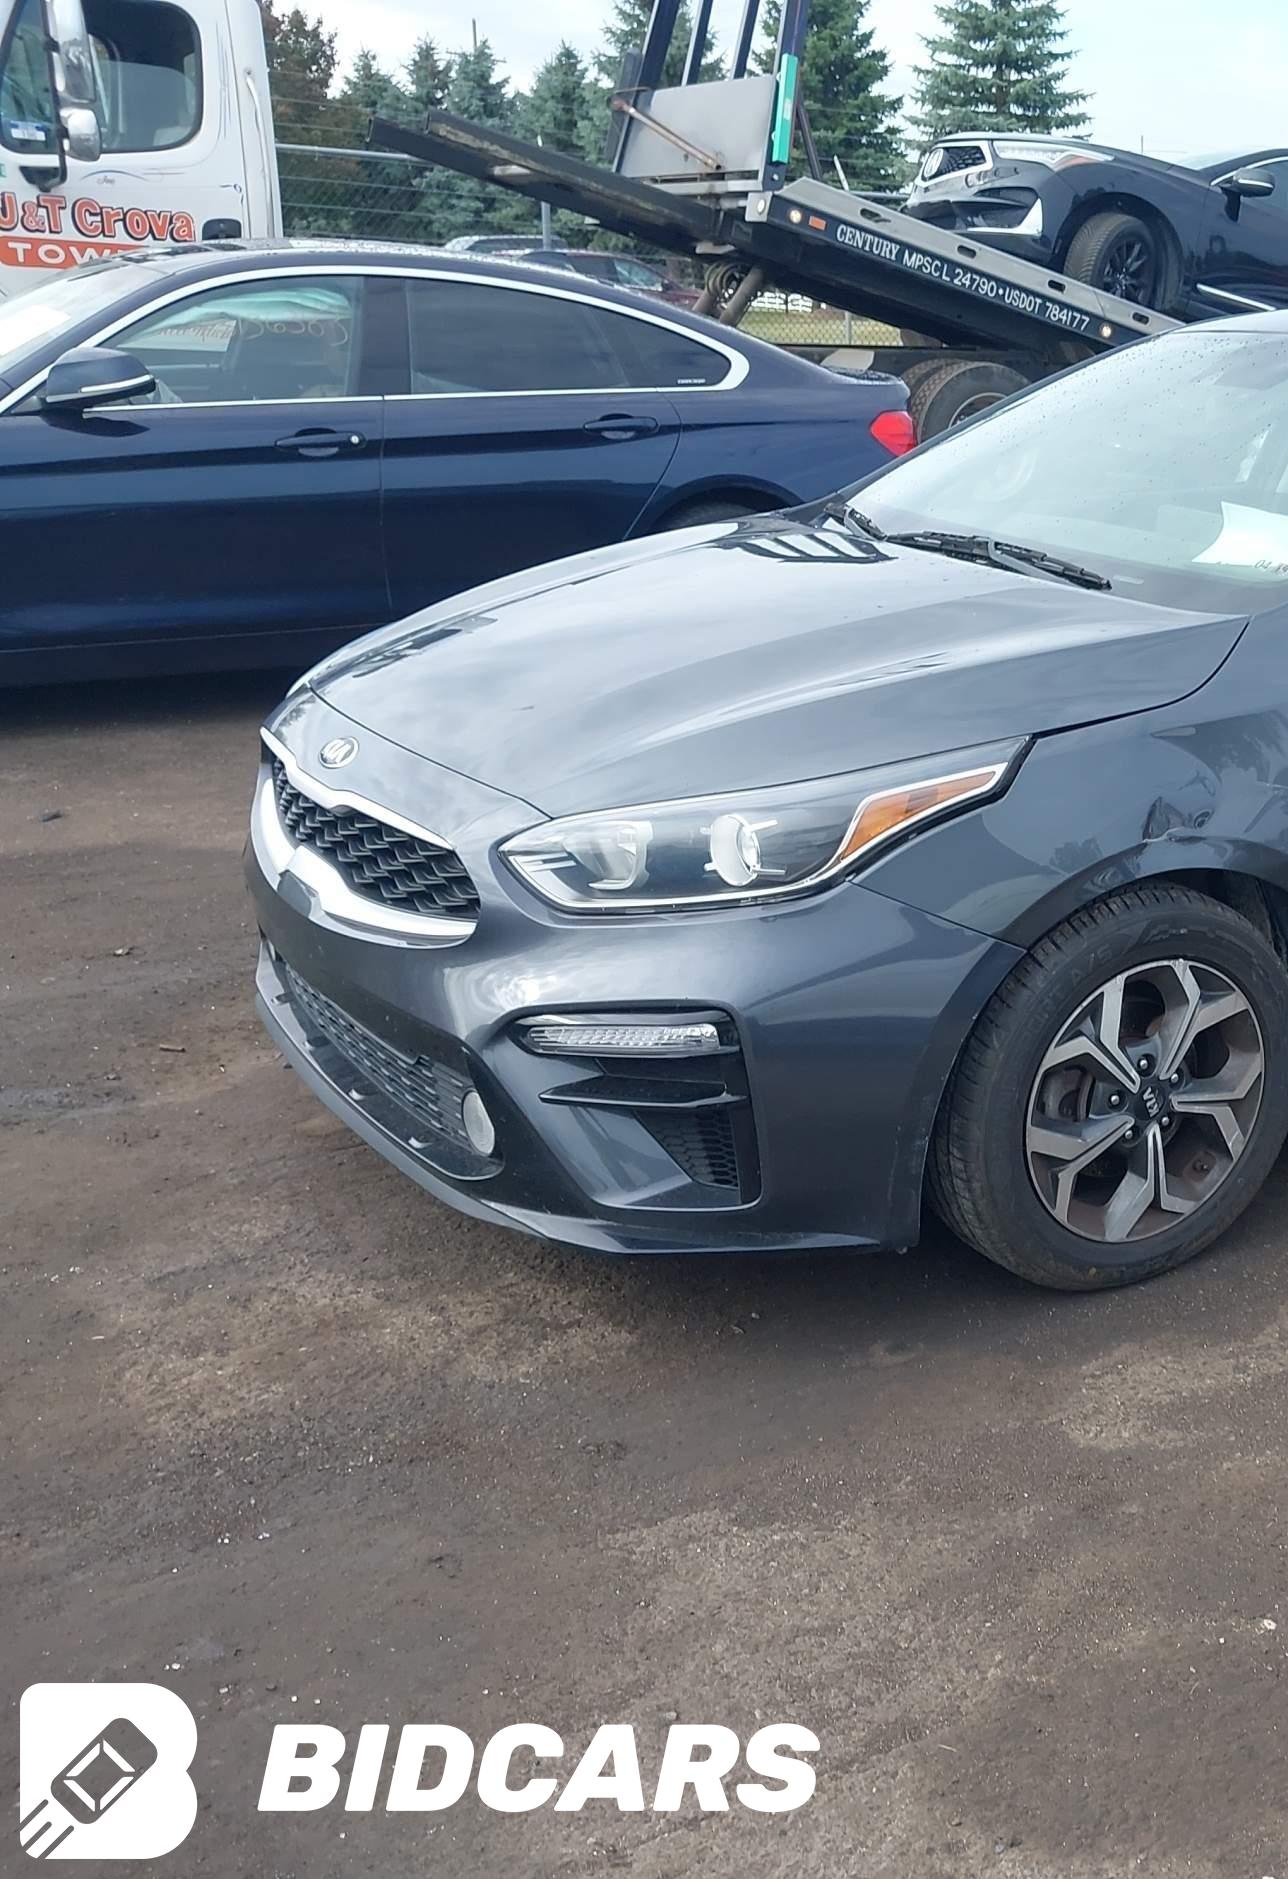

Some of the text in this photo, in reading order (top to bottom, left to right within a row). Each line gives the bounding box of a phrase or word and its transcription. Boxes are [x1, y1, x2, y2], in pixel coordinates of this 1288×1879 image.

[71, 197, 197, 242] Crova
[836, 224, 900, 261] CENTURY
[903, 249, 942, 277] MPSC
[953, 268, 997, 297] 24790
[1004, 287, 1042, 314] USDOT
[1045, 302, 1090, 332] 784177
